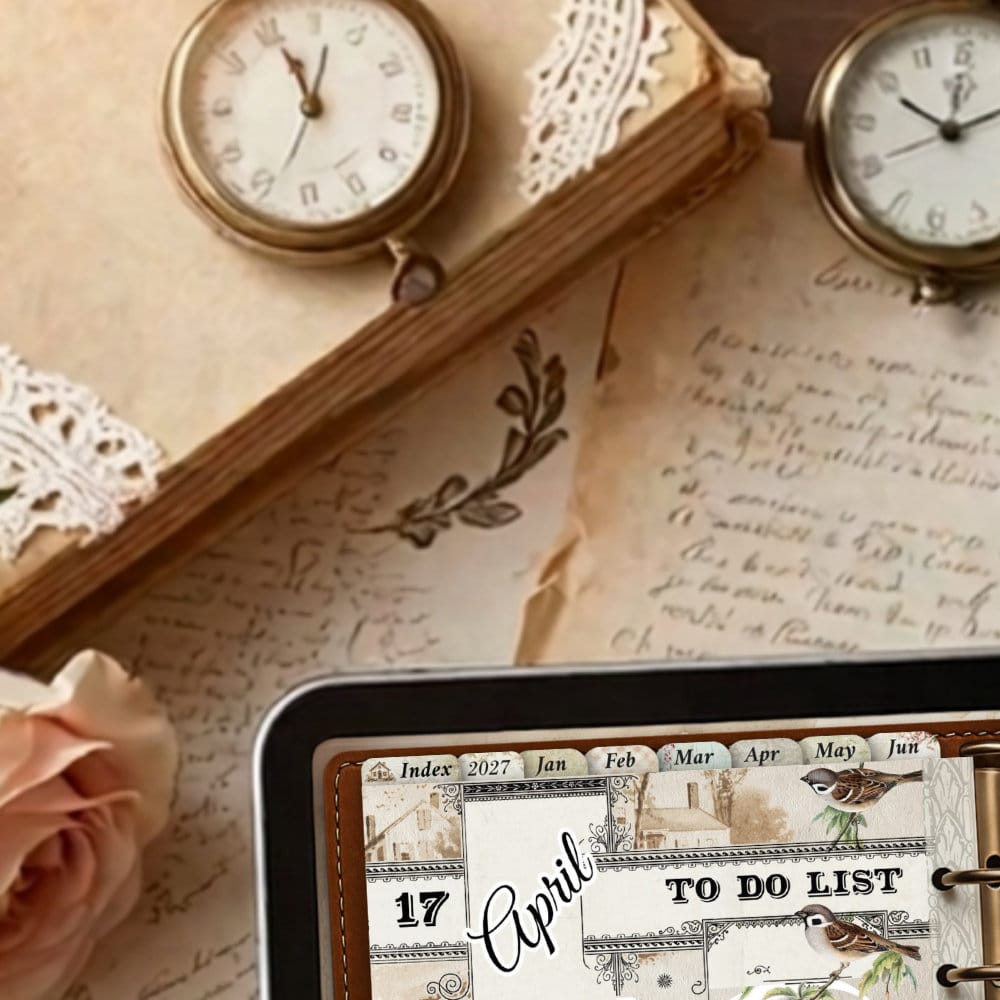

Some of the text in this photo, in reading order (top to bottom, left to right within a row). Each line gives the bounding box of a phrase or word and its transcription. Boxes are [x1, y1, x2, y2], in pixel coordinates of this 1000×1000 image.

[674, 748, 715, 766] Mar
[744, 746, 781, 766] Apr
[815, 741, 856, 762] May
[888, 739, 919, 757] Jun
[400, 760, 453, 779] Index
[468, 759, 511, 777] 2027
[535, 756, 567, 774] Jan
[605, 751, 636, 769] Feb
[665, 867, 903, 905] TO DO LIST
[395, 890, 450, 928] 17
[468, 831, 595, 972] April
